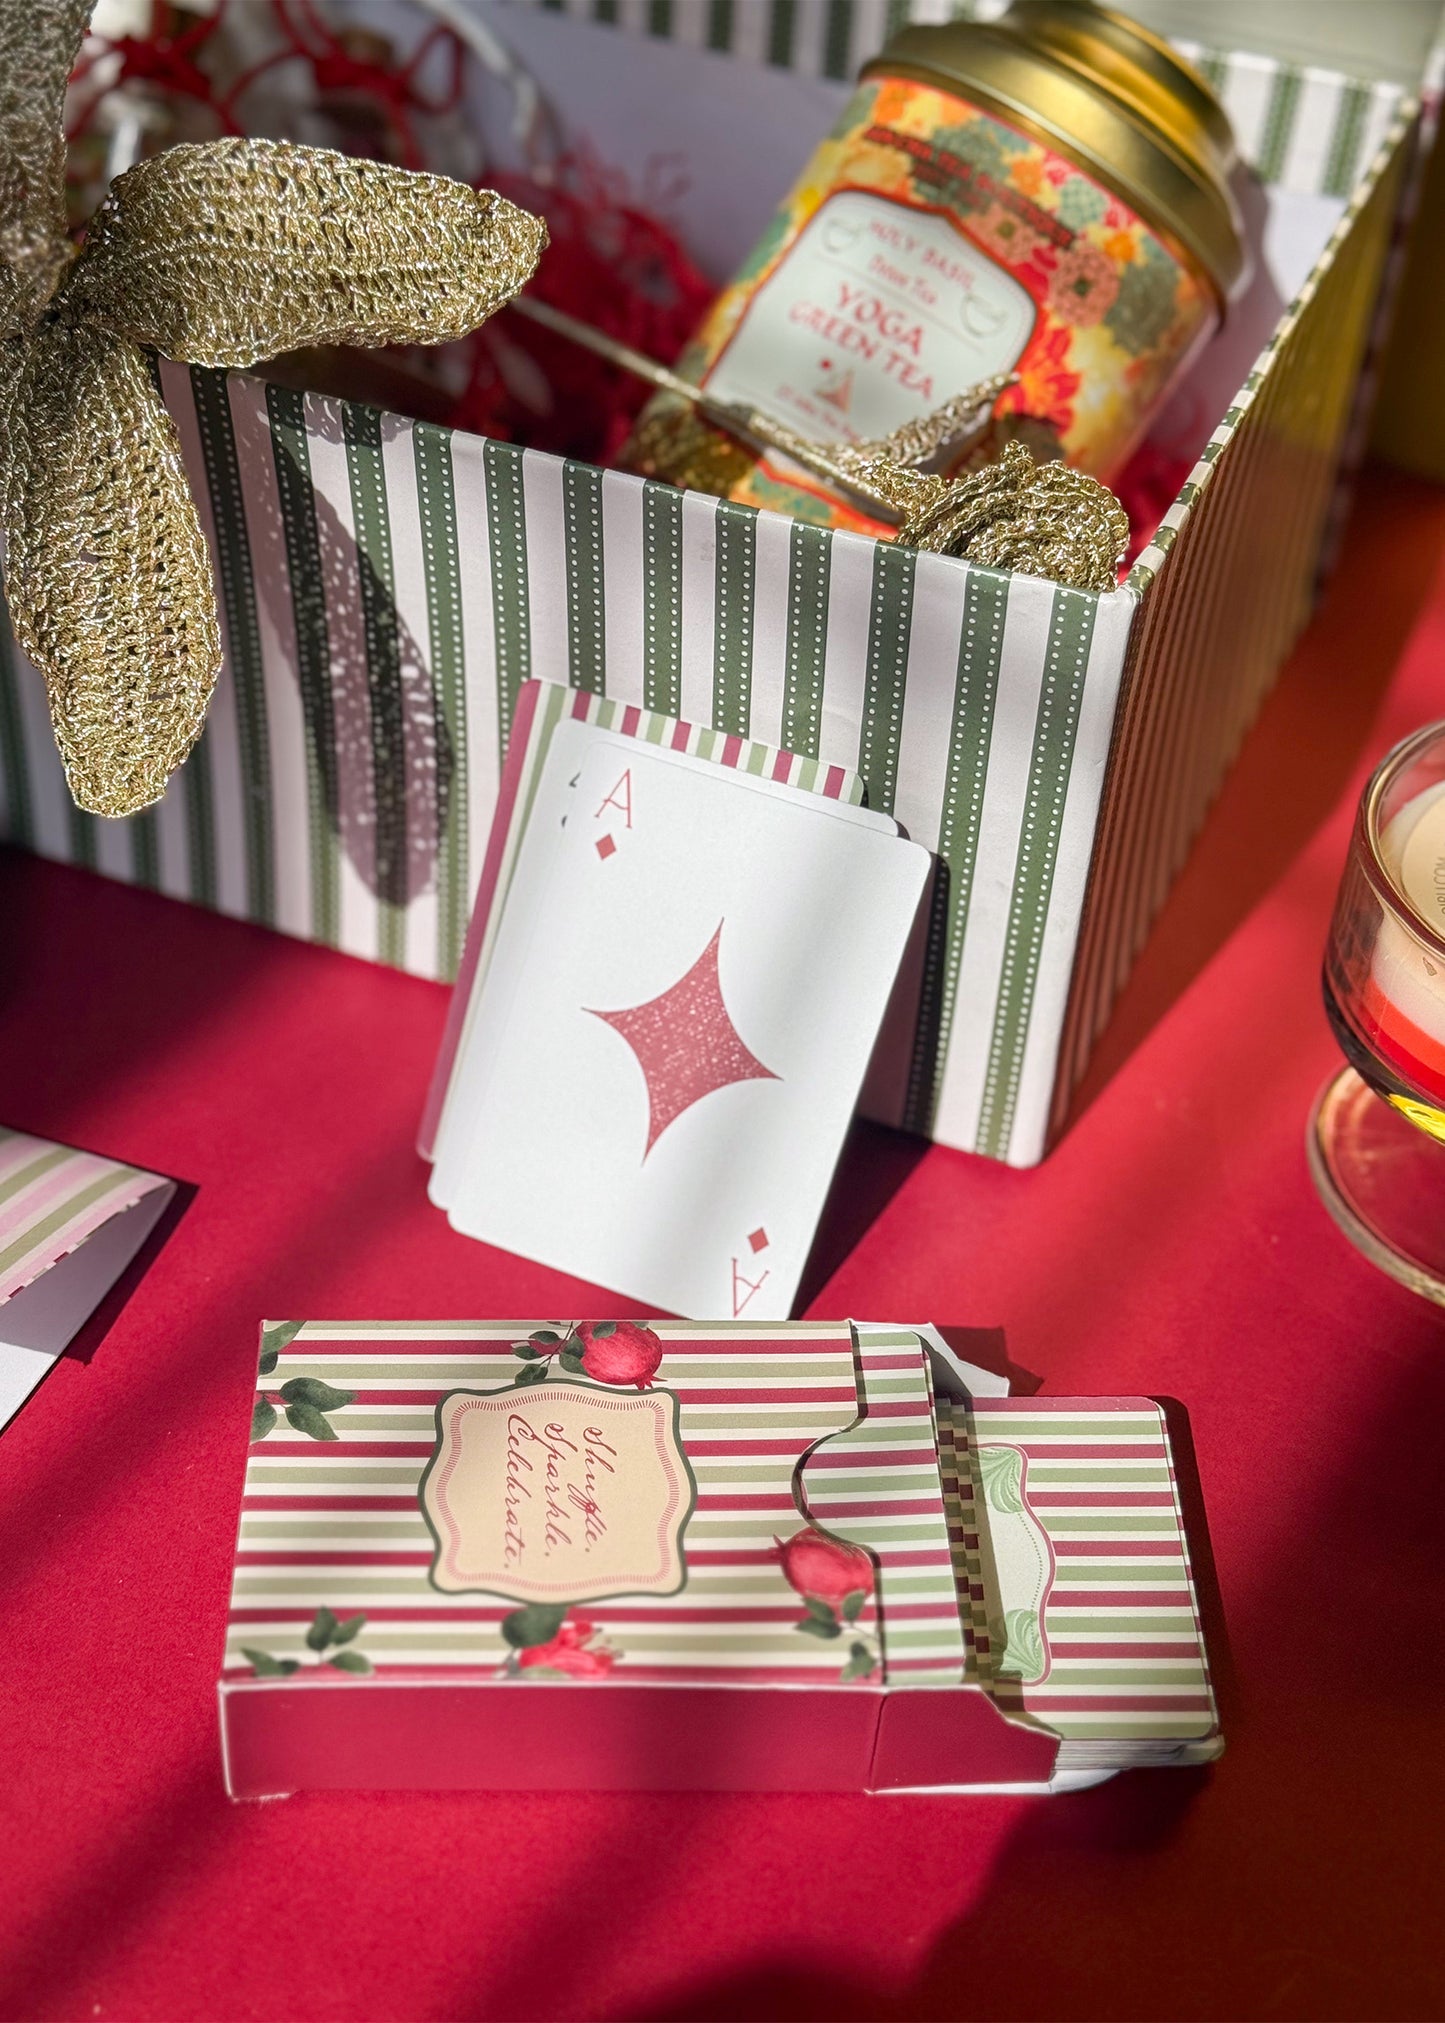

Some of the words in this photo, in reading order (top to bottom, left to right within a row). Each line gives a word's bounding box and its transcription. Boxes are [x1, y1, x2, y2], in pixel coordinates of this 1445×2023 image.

[868, 218, 919, 253] HOLY
[921, 246, 976, 294] BASIL
[788, 301, 881, 360] GREEN
[883, 350, 934, 400] TEA
[836, 281, 923, 356] YOGA
[594, 768, 632, 829] A
[731, 1257, 770, 1319] A
[504, 1413, 536, 1569] Celebrate.
[533, 1422, 579, 1557] Sparkle.
[567, 1427, 618, 1552] Shuffle.
